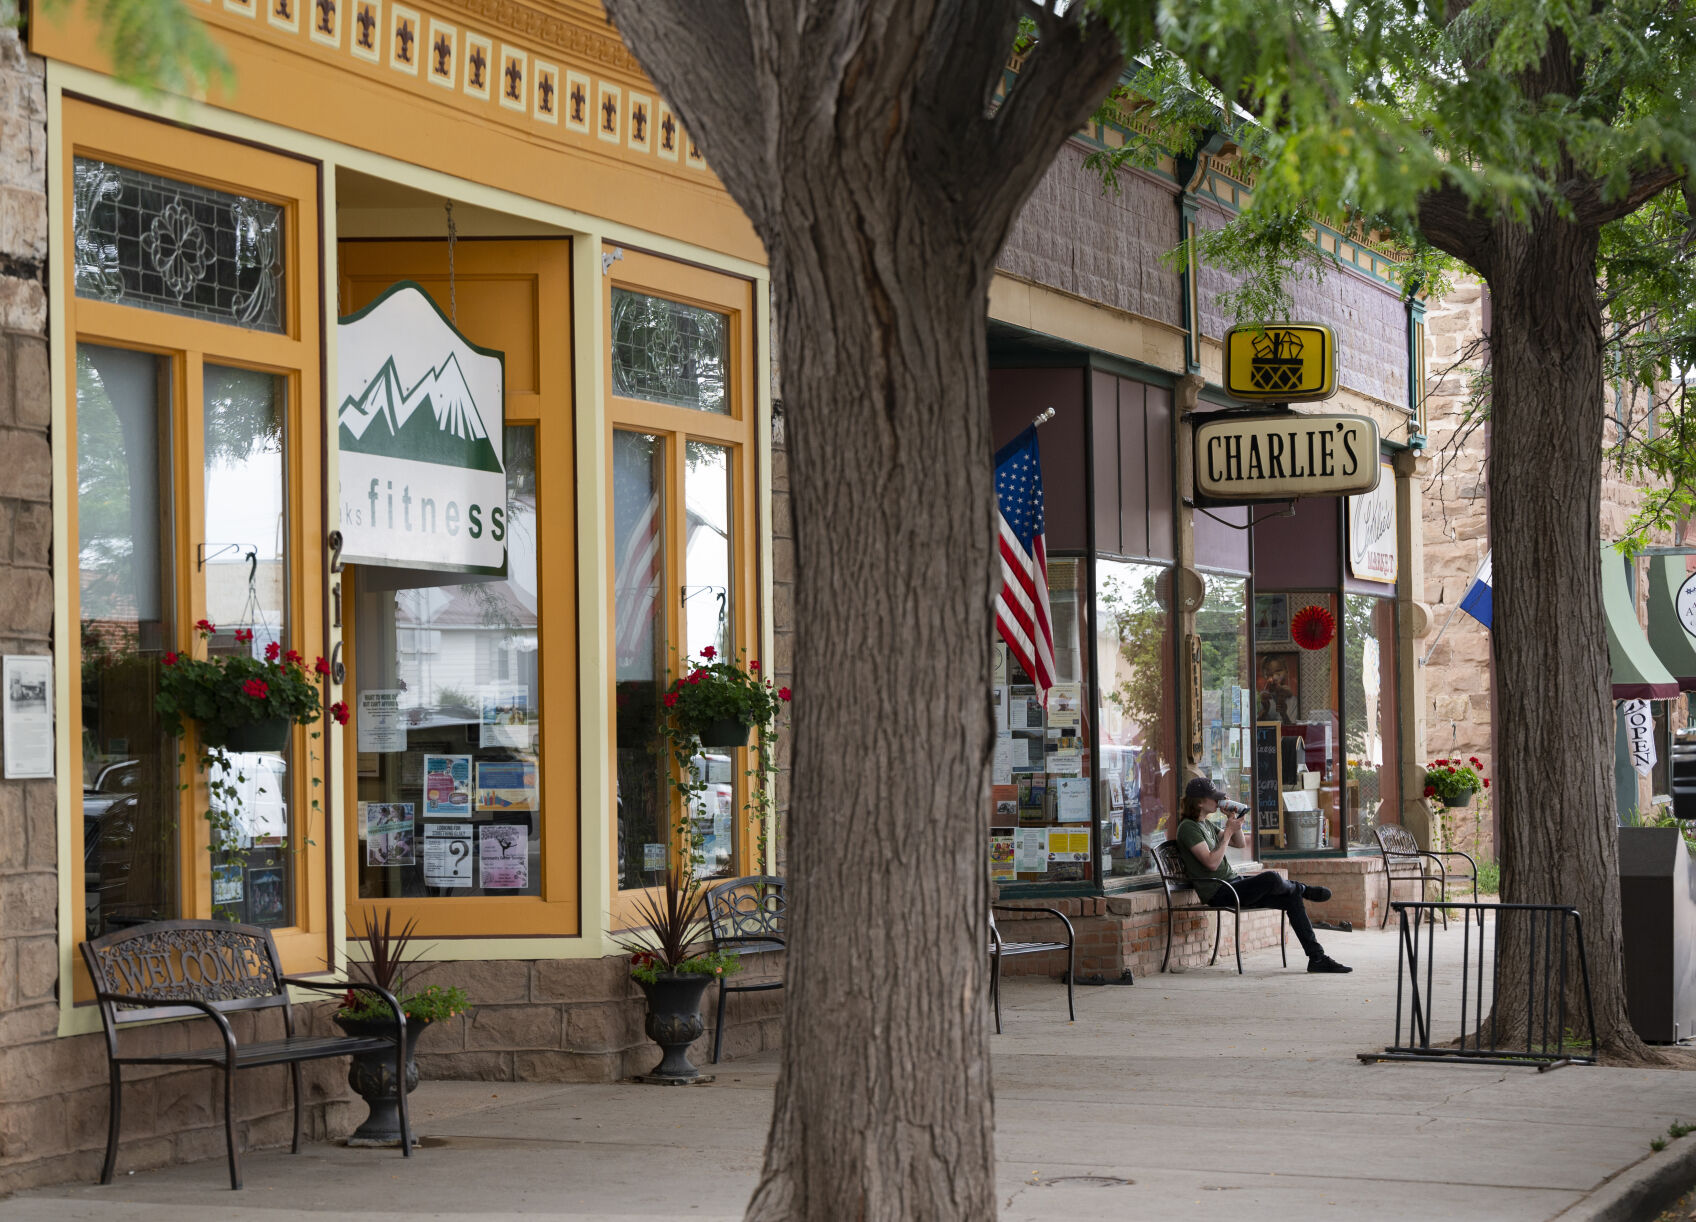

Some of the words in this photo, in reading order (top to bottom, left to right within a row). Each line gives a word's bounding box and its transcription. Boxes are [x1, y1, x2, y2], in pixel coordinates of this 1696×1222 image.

[1207, 423, 1359, 483] CHARLIE'S
[368, 478, 506, 542] fitness
[1367, 552, 1394, 576] MARKET
[1630, 714, 1651, 764] OPEN
[114, 946, 261, 994] WELCOME
